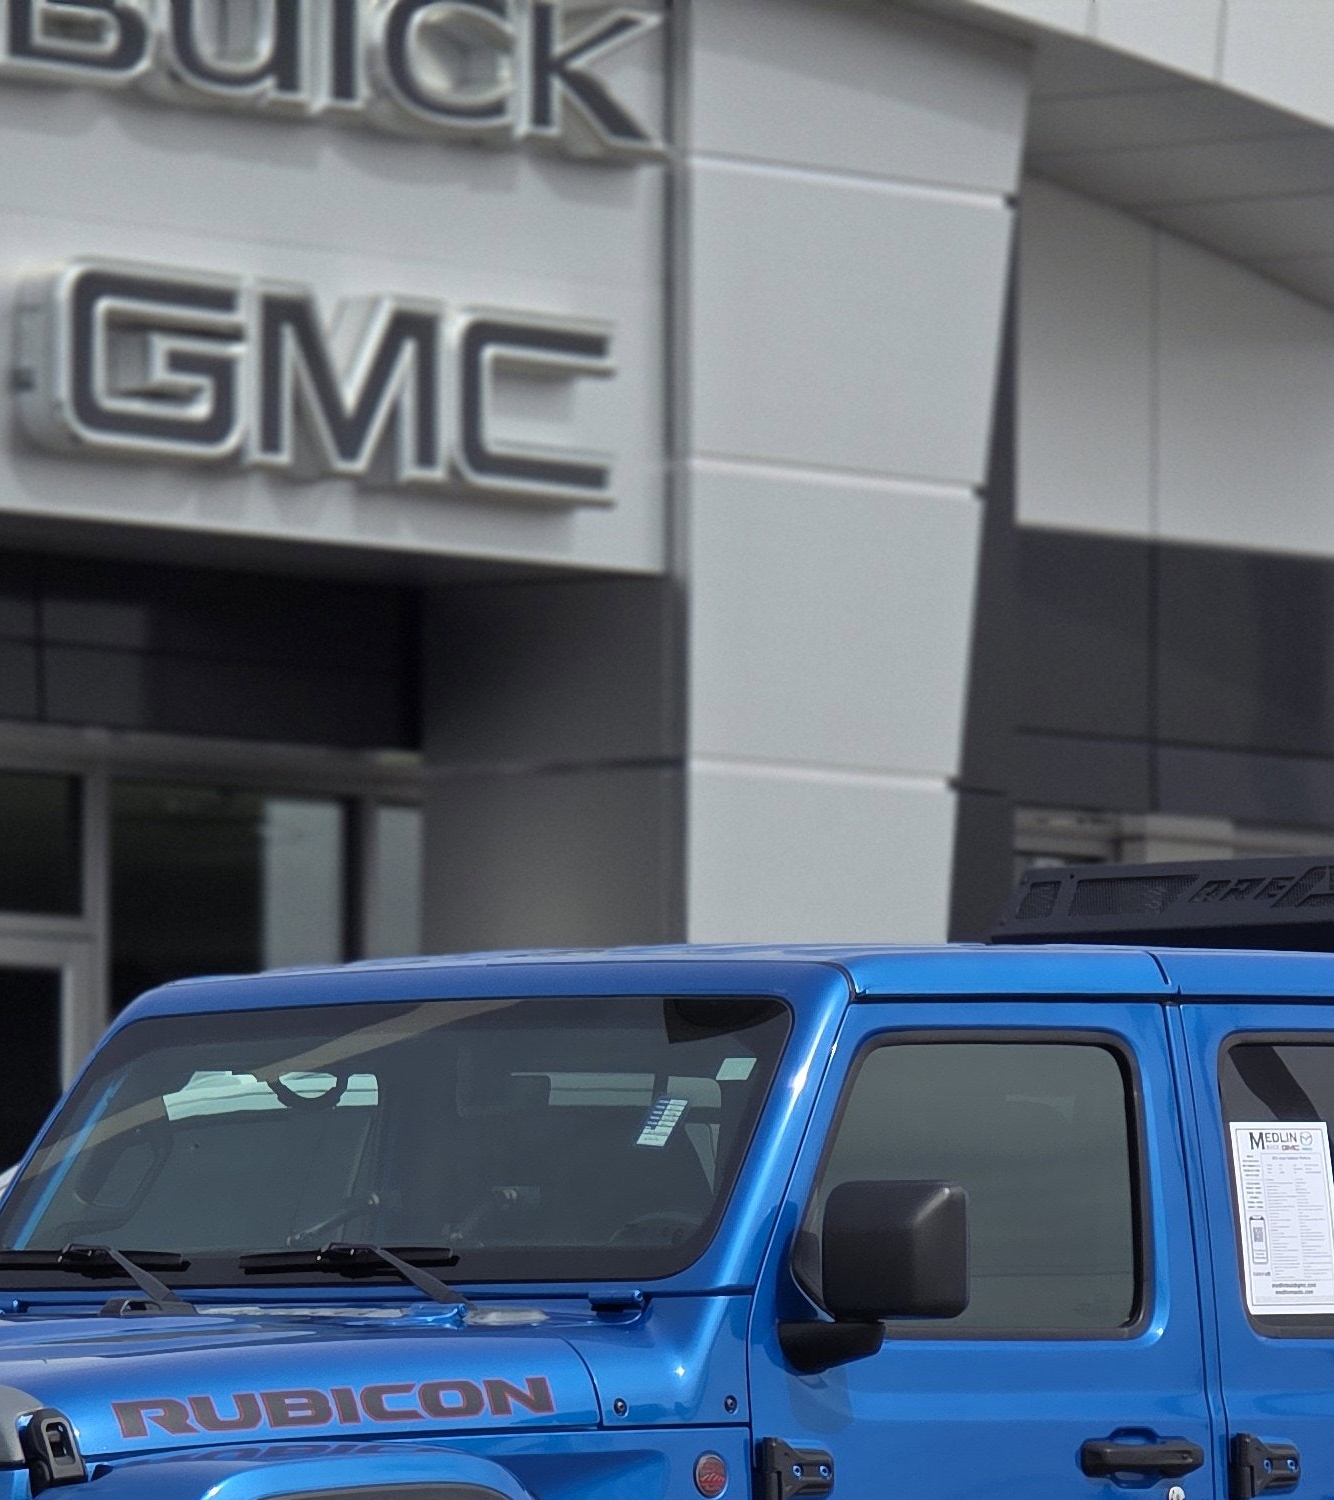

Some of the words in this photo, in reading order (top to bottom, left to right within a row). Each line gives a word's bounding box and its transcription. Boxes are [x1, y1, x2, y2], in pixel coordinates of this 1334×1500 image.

[65, 260, 615, 507] GMC
[1249, 1131, 1298, 1151] MEDLIN
[110, 1376, 554, 1439] RUBICON
